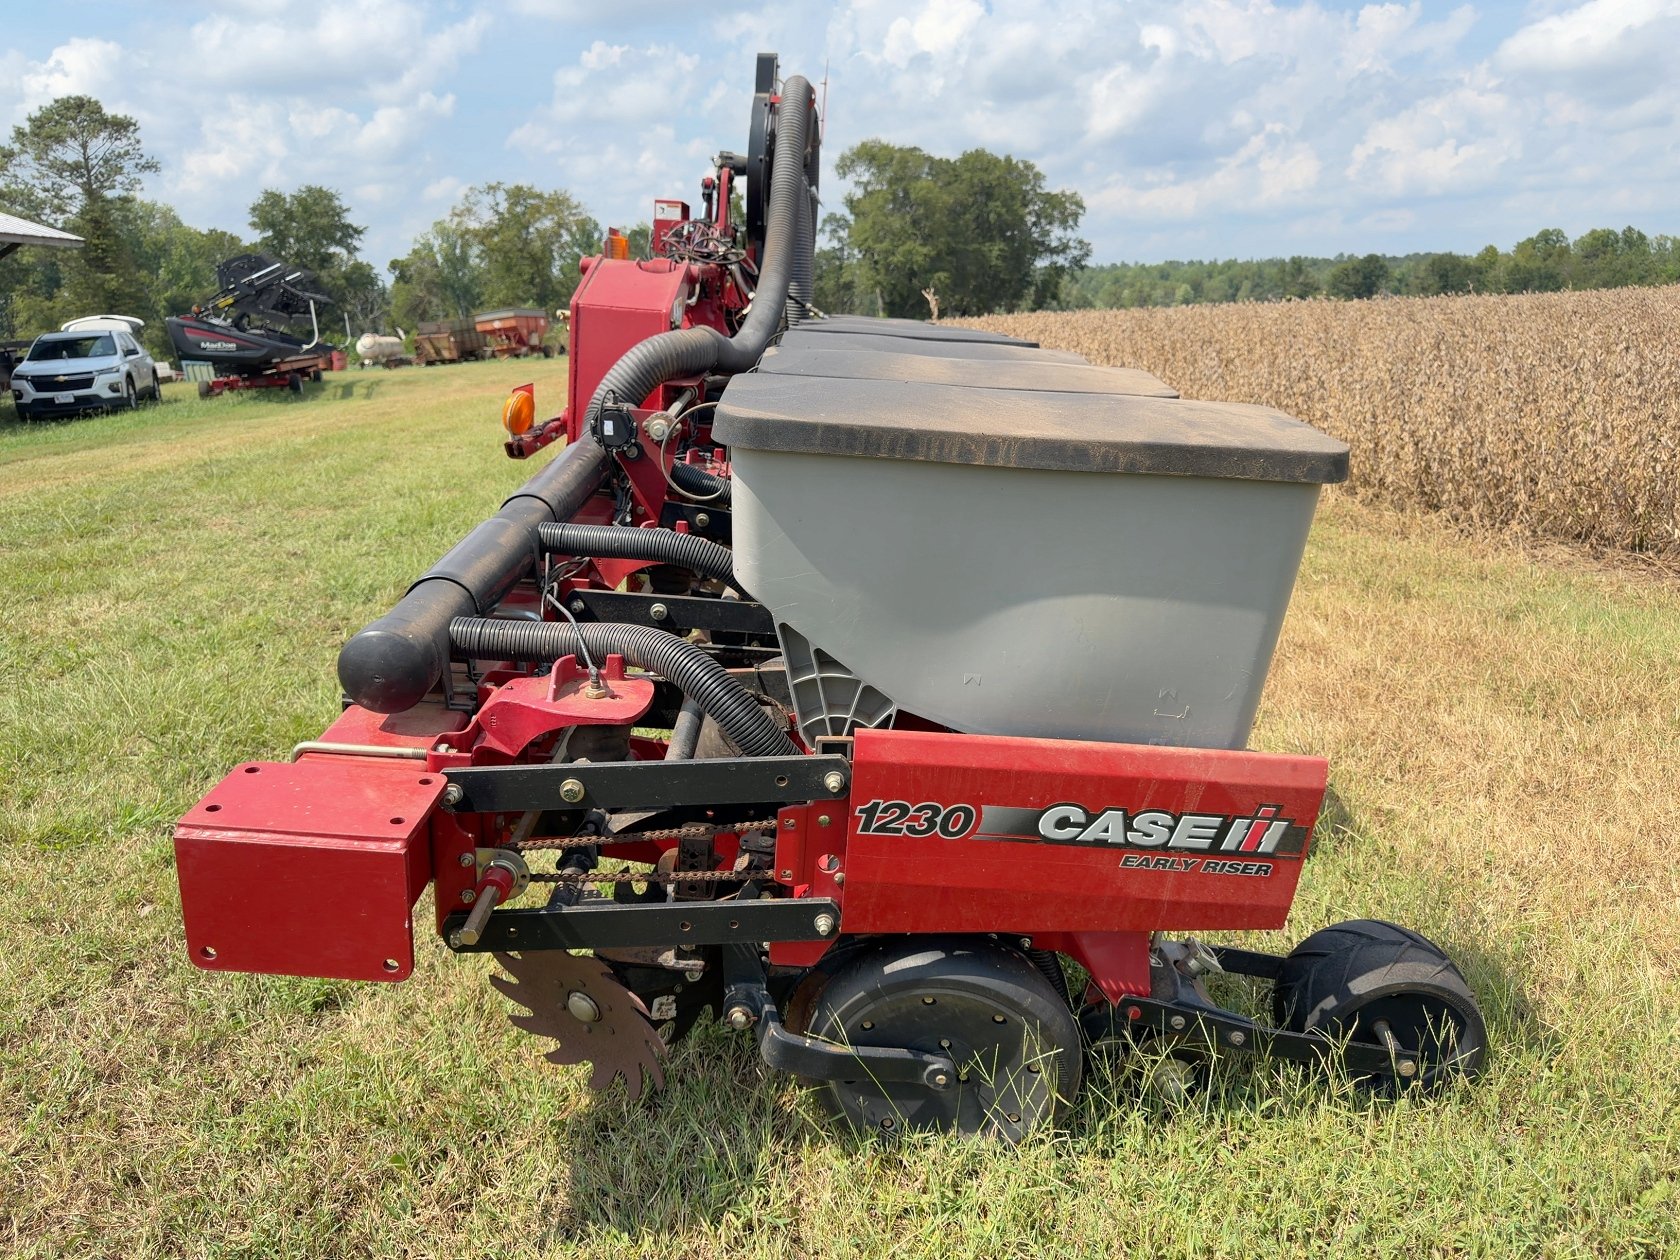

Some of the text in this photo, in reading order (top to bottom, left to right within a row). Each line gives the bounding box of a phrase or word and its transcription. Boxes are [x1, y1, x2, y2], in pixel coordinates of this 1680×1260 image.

[855, 799, 976, 839] 1230
[1038, 805, 1224, 850] CASE
[1119, 855, 1273, 877] EARLY RISER
